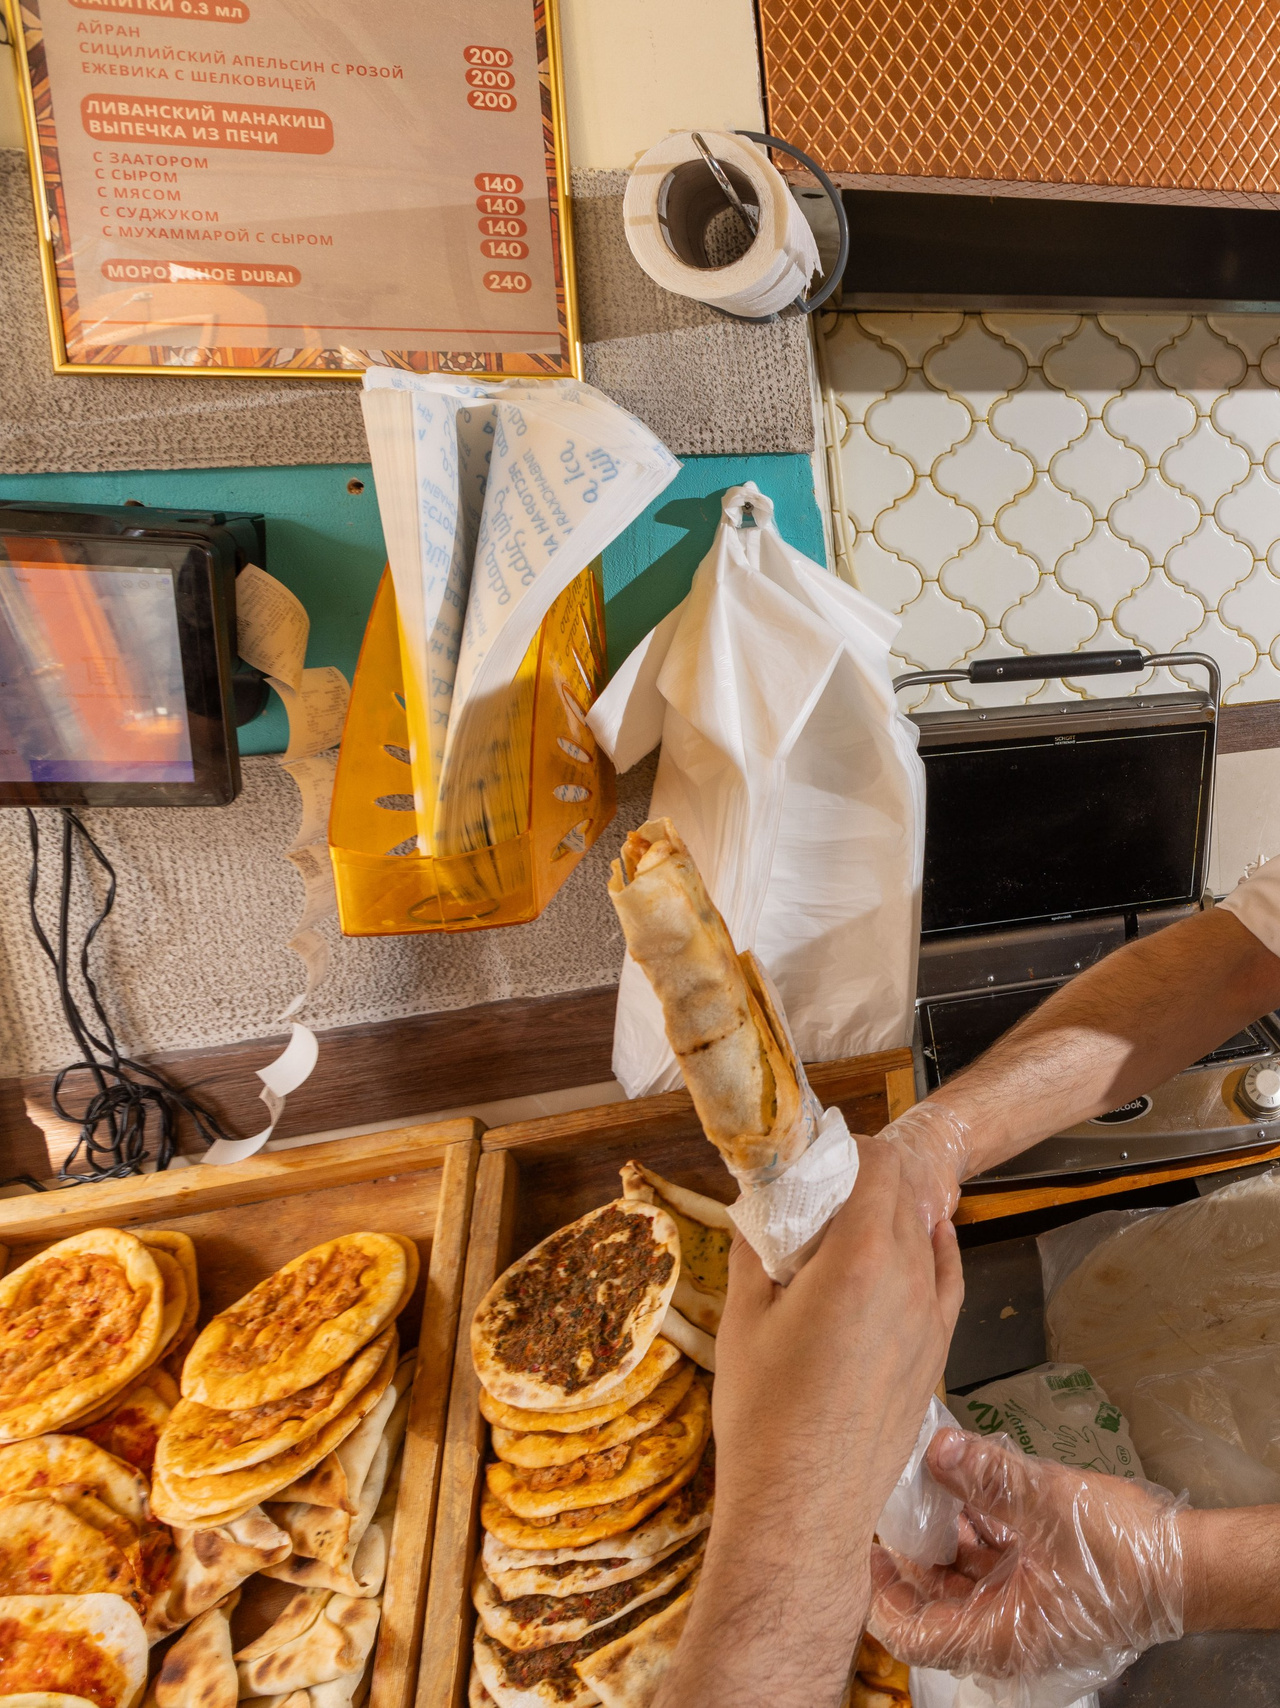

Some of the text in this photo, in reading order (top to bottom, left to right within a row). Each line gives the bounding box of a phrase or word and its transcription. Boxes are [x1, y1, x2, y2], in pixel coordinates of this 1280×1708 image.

[70, 0, 243, 18] ИТКИ 0.3 мл
[76, 20, 141, 38] АЙРАН
[79, 42, 403, 79] СИЦИЛИЙСКИЙ АПЕЛЬСИН С РОЗОЙ
[469, 47, 508, 66] 200
[81, 61, 316, 92] ЕЖЕВИКА С ШЕЛКОВИЦЕЙ
[471, 69, 510, 88] 200
[473, 91, 512, 109] 200
[86, 99, 326, 130] ЛИВАНСКИЙ МАНАКИШ
[88, 119, 279, 145] ВЫПЕЧКА ИЗ ПЕЧИ
[93, 151, 209, 169] С ЗААТОРОМ
[95, 168, 178, 183] С СЫРОМ
[482, 176, 517, 193] 140
[97, 186, 182, 202] С МЯСОМ
[100, 206, 220, 223] С СУДЖУКОМ
[484, 198, 519, 215] 140
[102, 225, 334, 247] С МУХАММАРОЙ С СЫРОМ
[486, 220, 520, 236] 140
[488, 242, 522, 257] 140
[107, 264, 294, 284] МОРОНОЕ DUBAI
[489, 274, 527, 290] 240
